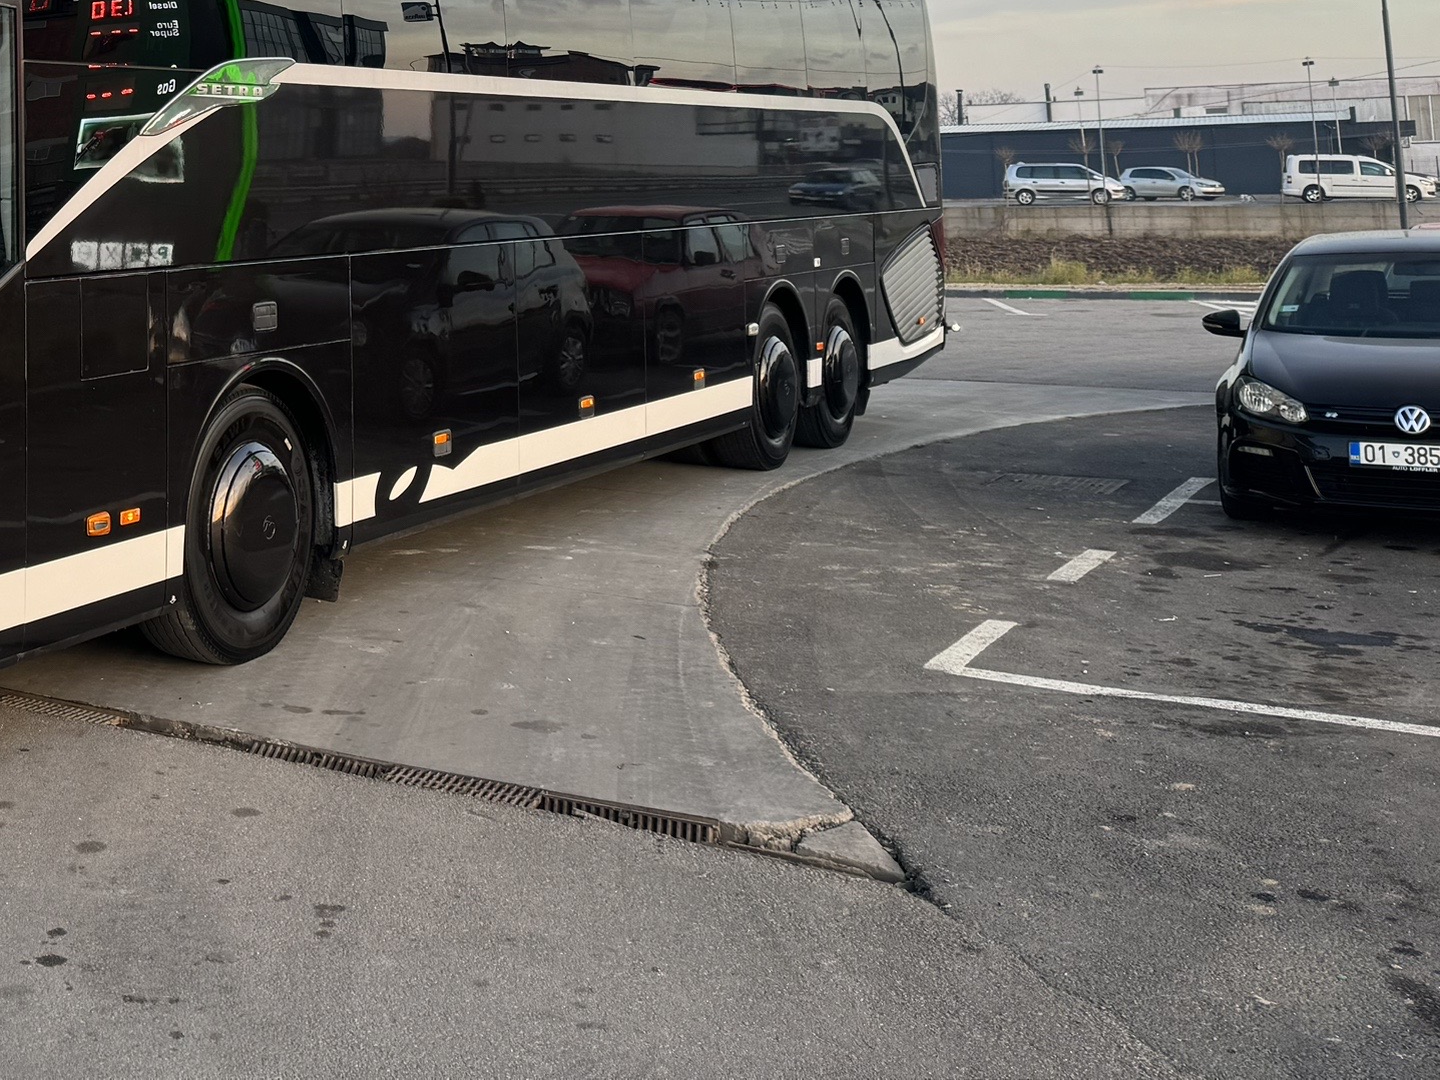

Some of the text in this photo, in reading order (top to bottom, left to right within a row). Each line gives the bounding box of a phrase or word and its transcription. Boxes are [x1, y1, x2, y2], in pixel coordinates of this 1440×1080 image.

[195, 83, 264, 97] SETRA
[1364, 443, 1440, 466] 01 385
